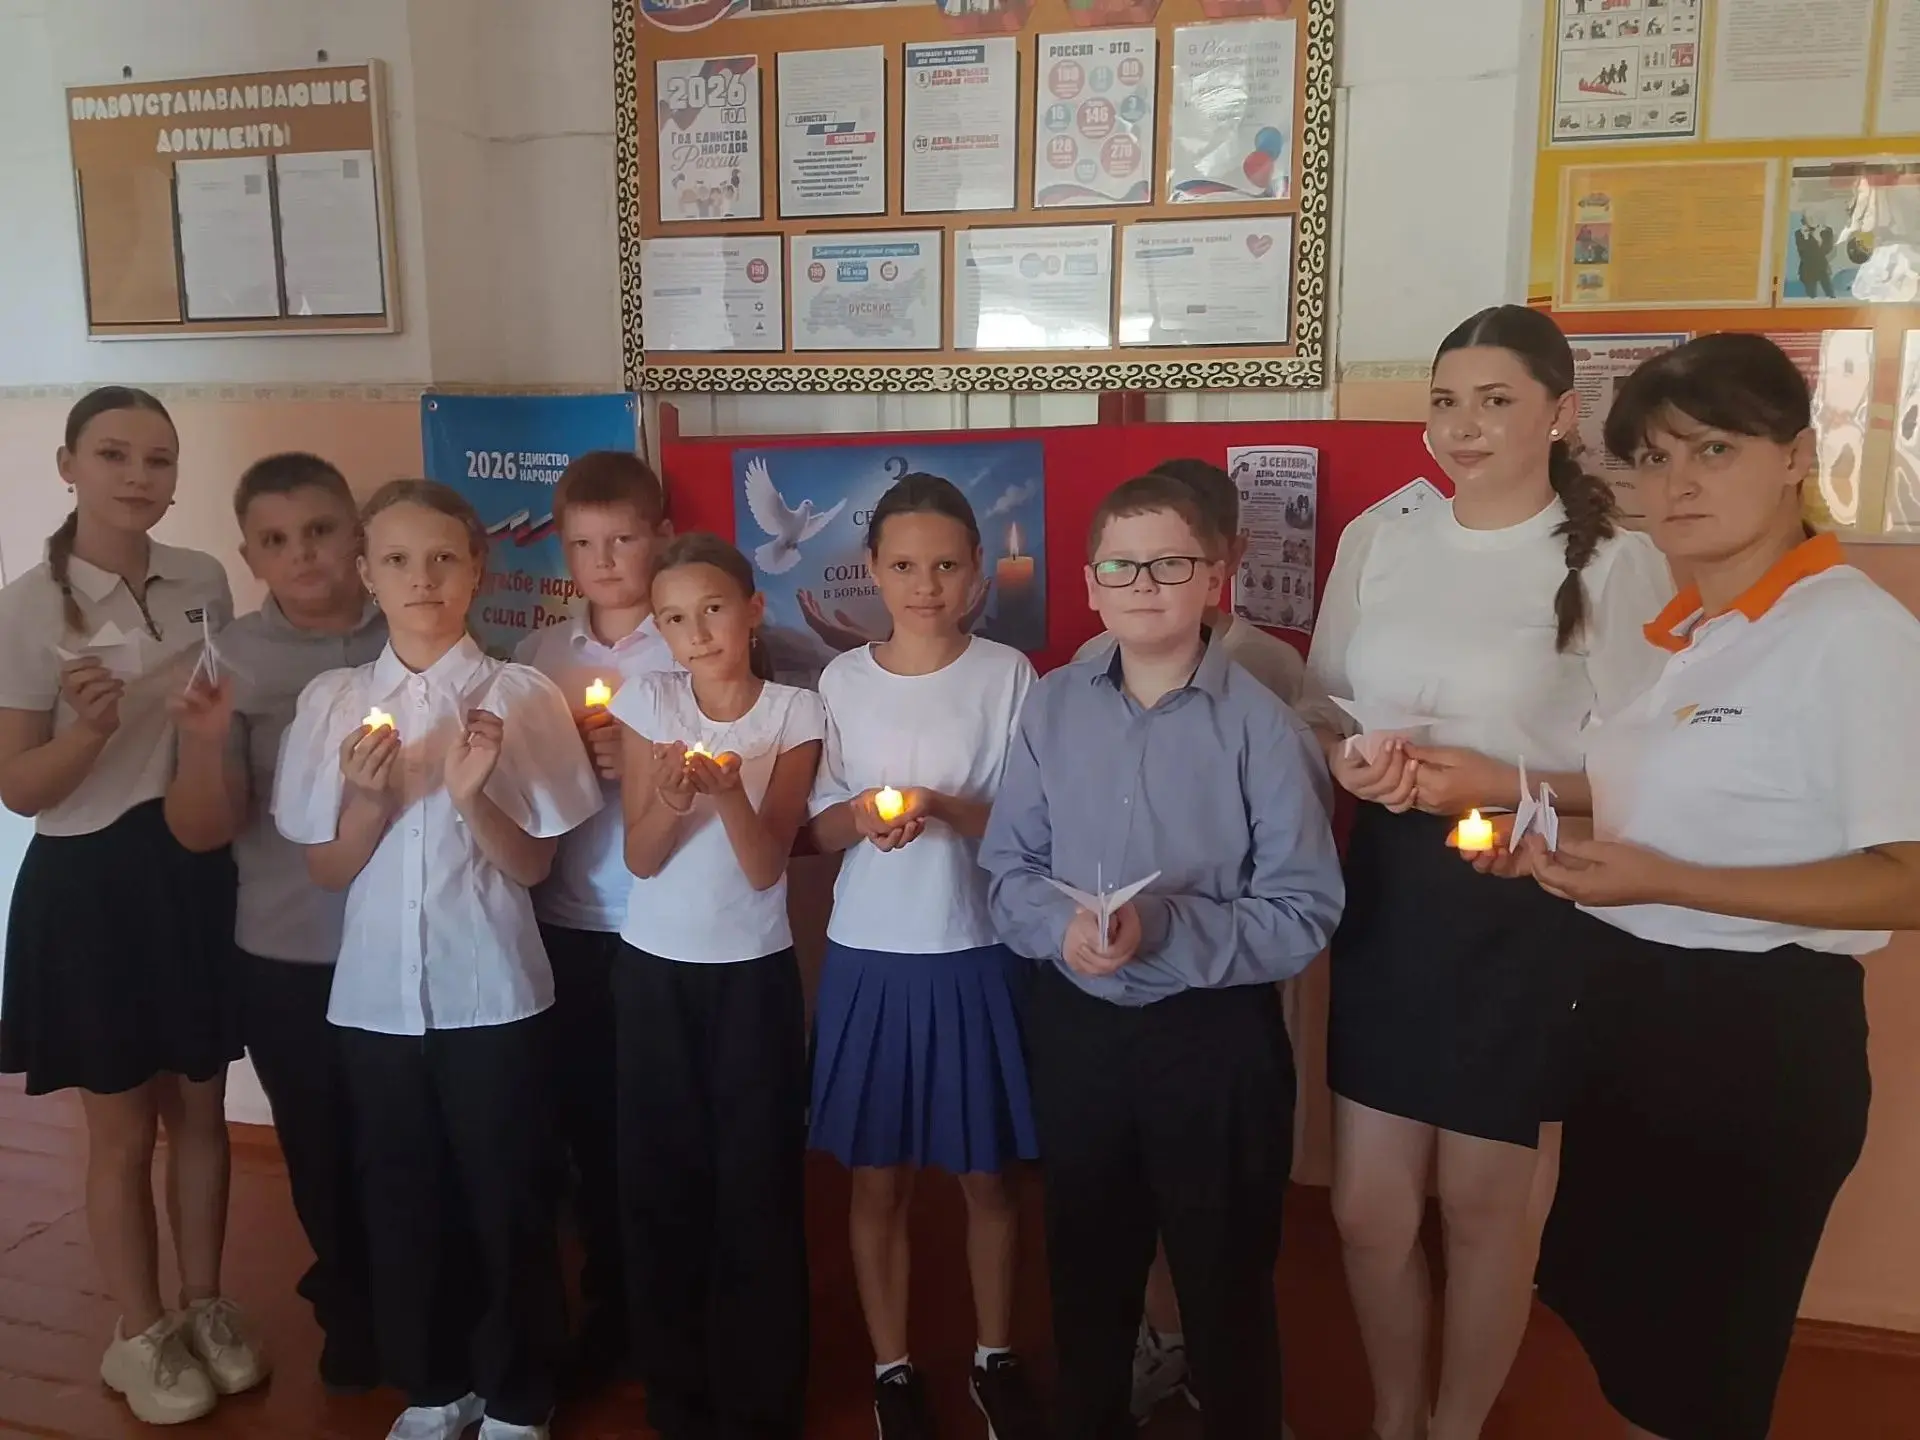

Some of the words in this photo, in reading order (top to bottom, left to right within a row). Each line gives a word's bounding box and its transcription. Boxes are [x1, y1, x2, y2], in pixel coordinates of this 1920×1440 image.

[1050, 44, 1093, 57] РОССИЯ
[1109, 42, 1130, 54] ЭТО
[72, 79, 367, 120] ПРАВОУСТАНАВЛИВАЮЩИЕ
[667, 74, 746, 109] 2026
[156, 123, 291, 153] ДОКУМЕНТЫ
[465, 450, 517, 480] 2026
[519, 452, 570, 467] ЕДИНСТВО
[834, 585, 878, 600] БОРЬБЕ
[482, 606, 527, 628] сила
